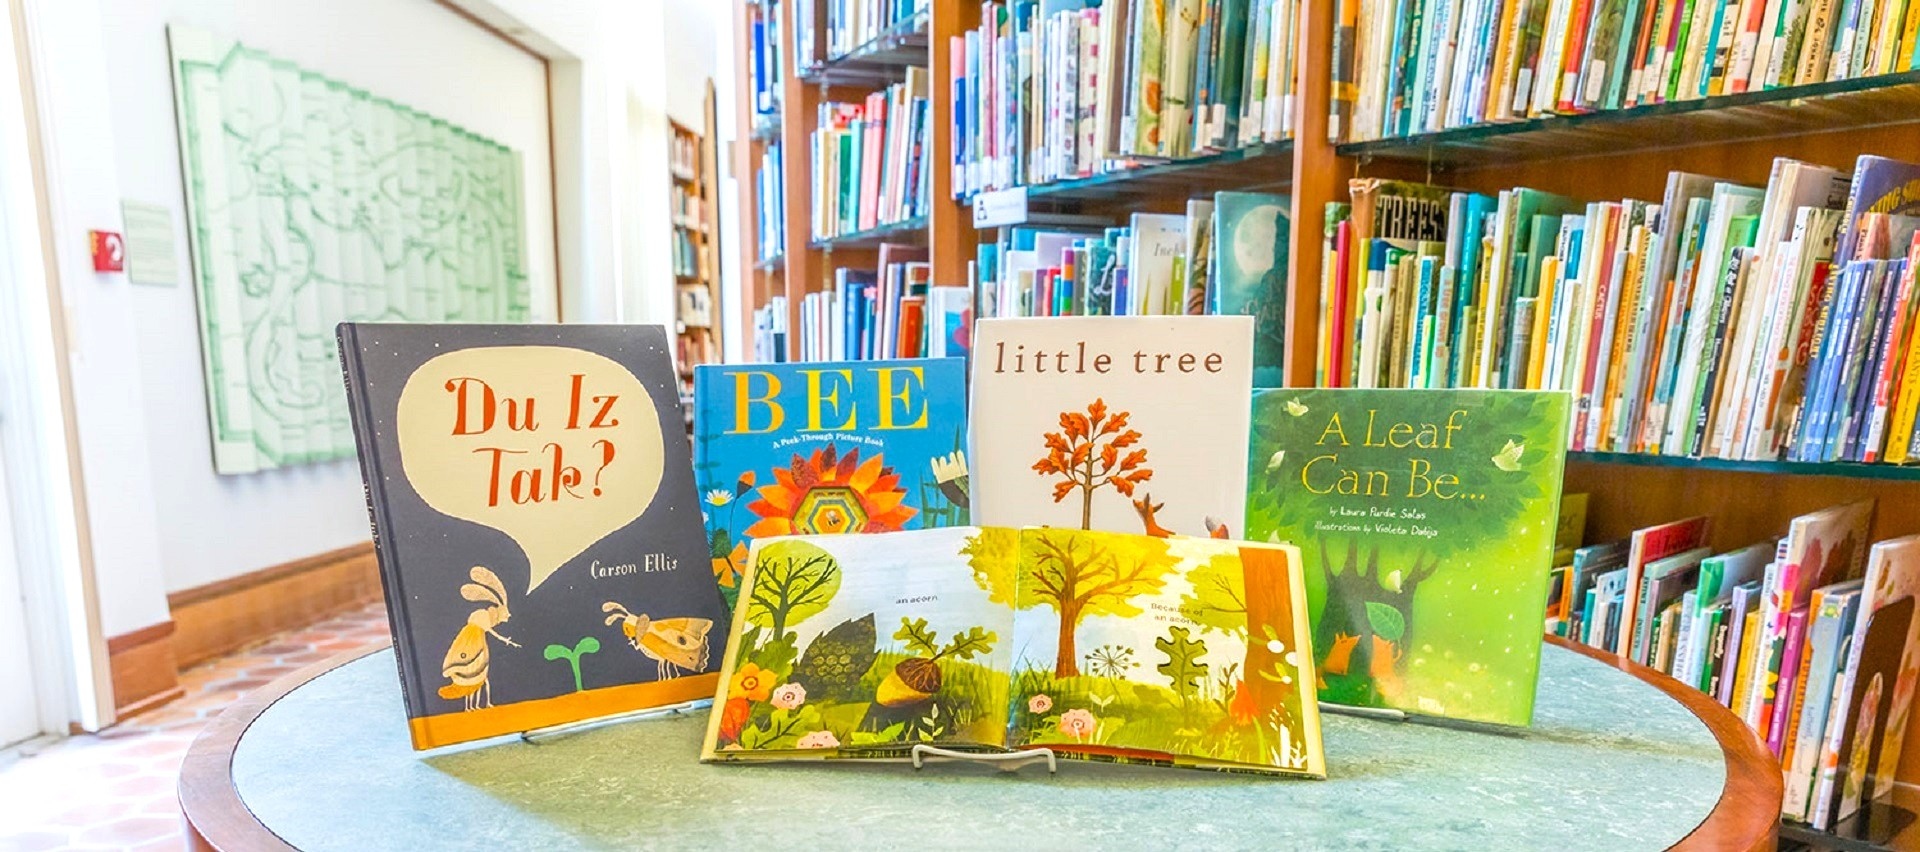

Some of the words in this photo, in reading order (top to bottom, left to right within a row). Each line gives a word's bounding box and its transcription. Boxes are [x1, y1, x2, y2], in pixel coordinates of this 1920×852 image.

[1377, 194, 1440, 241] TREES
[1594, 283, 1605, 320] CACTUS
[994, 341, 1112, 374] little
[1133, 350, 1223, 374] tree
[444, 376, 539, 436] Du
[564, 373, 620, 430] Iz
[723, 366, 928, 435] BEE
[772, 441, 781, 449] A
[781, 432, 833, 447] Peek-Through
[836, 433, 863, 444] Picture
[864, 435, 884, 447] Book
[1315, 411, 1349, 447] A
[1363, 409, 1468, 449] Leaf
[472, 439, 616, 507] Tak?
[1301, 454, 1390, 496] Can
[1406, 458, 1486, 500] Be...
[1329, 506, 1338, 518] by
[1340, 506, 1366, 517] Laura
[1370, 506, 1396, 518] Purdie
[1400, 508, 1426, 520] Salas
[1363, 525, 1372, 535] by
[1375, 524, 1407, 535] Violeta
[1411, 525, 1438, 539] Dabija
[590, 559, 637, 580] Carson
[644, 552, 678, 573] Ellis
[909, 595, 938, 604] acorn
